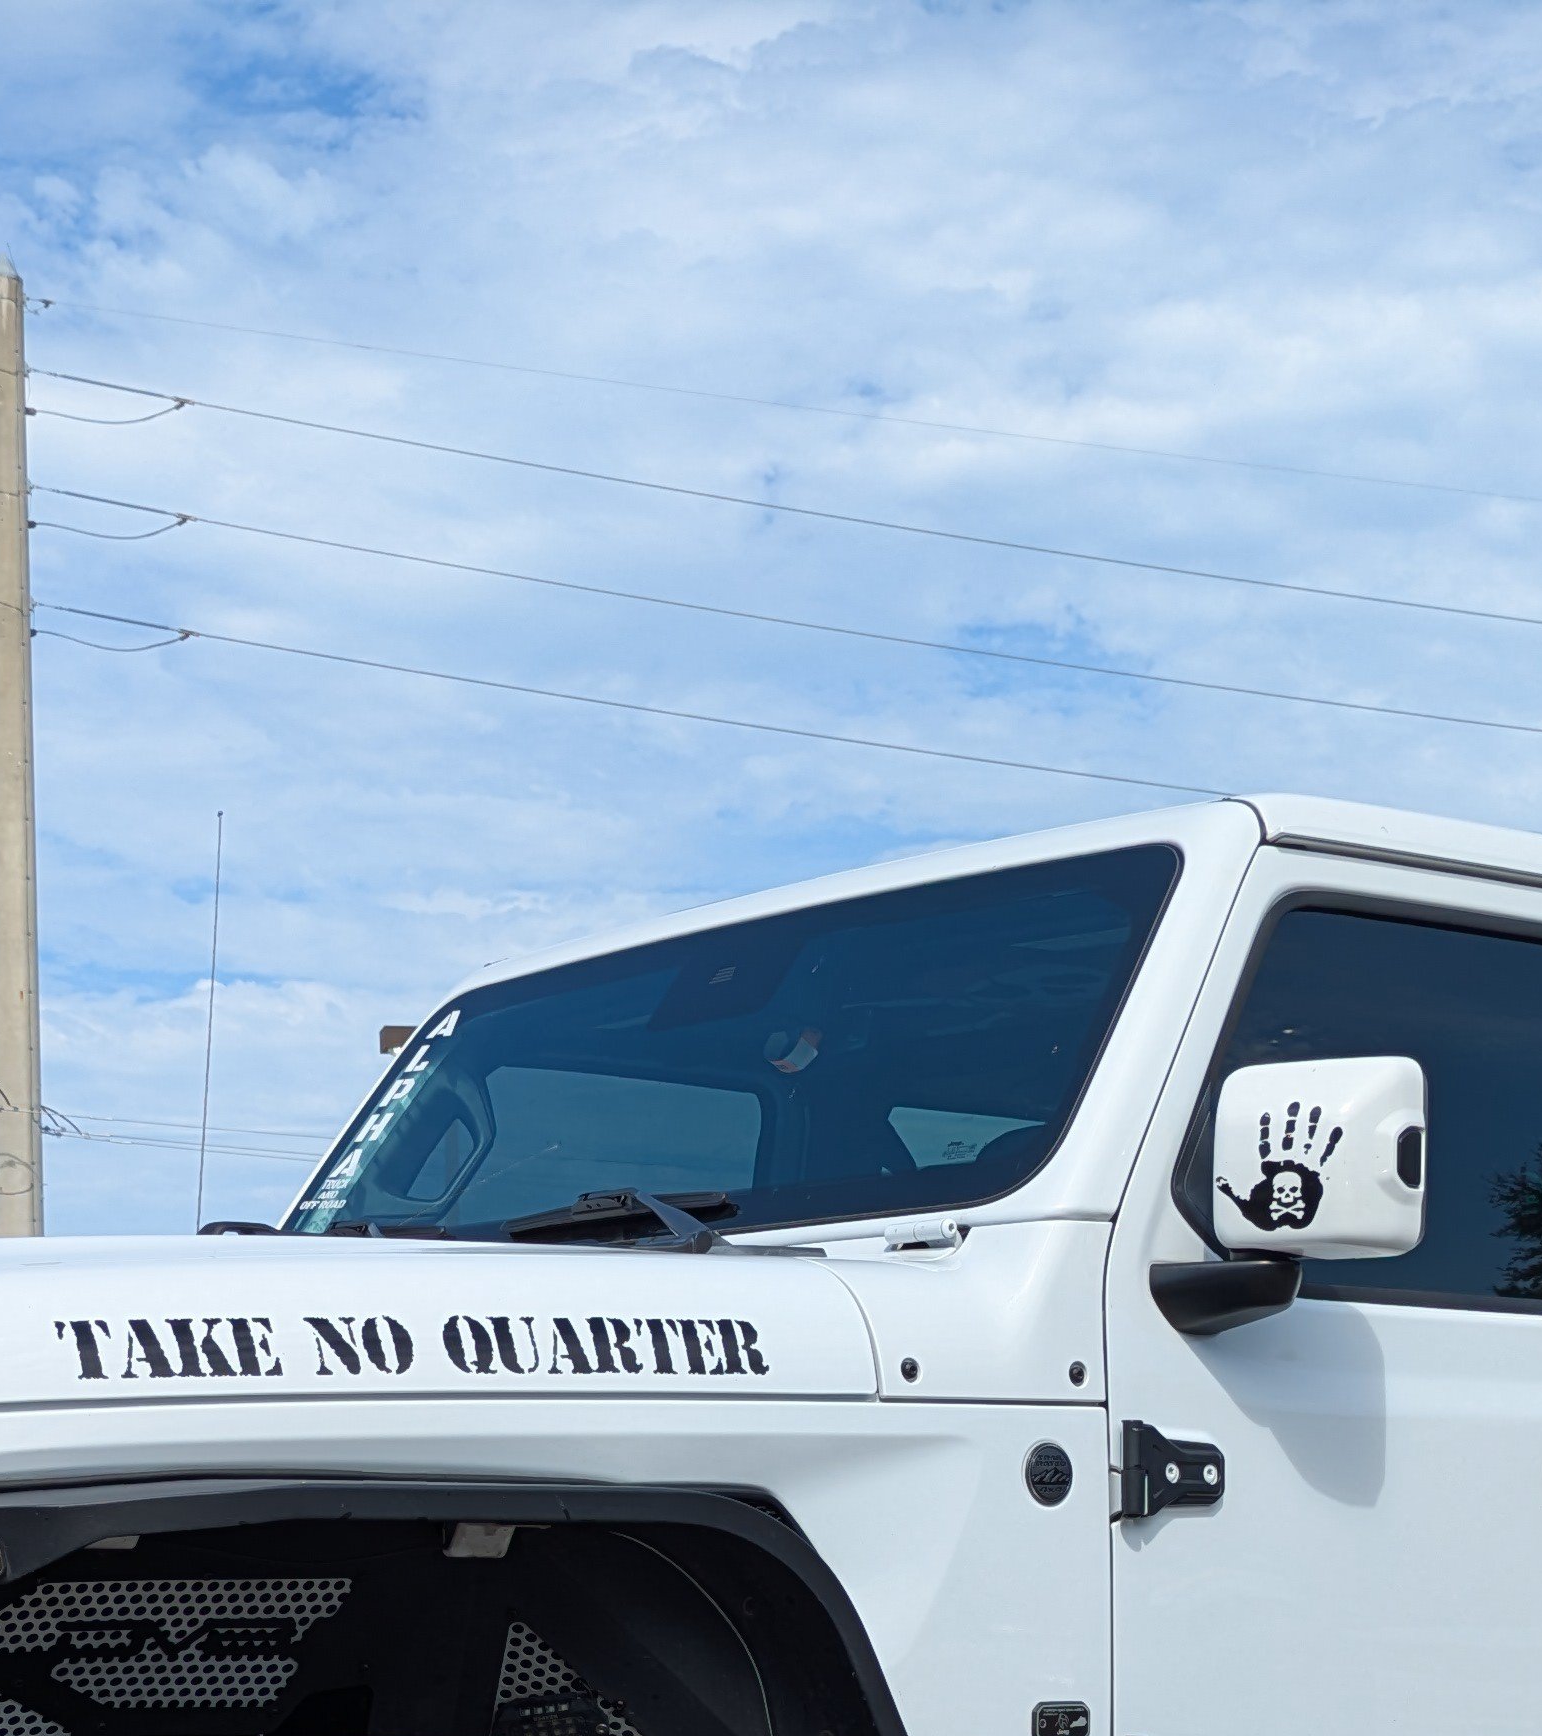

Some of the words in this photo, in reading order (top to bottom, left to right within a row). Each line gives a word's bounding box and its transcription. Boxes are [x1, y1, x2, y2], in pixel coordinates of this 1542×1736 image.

[328, 1010, 460, 1178] ALPHA
[322, 1179, 351, 1190] TRUCK
[318, 1190, 339, 1199] AND
[299, 1200, 320, 1210] OFF
[318, 1200, 347, 1209] ROAD
[54, 1317, 284, 1380] TAKE
[303, 1314, 415, 1376] NO
[442, 1314, 770, 1377] QUARTER
